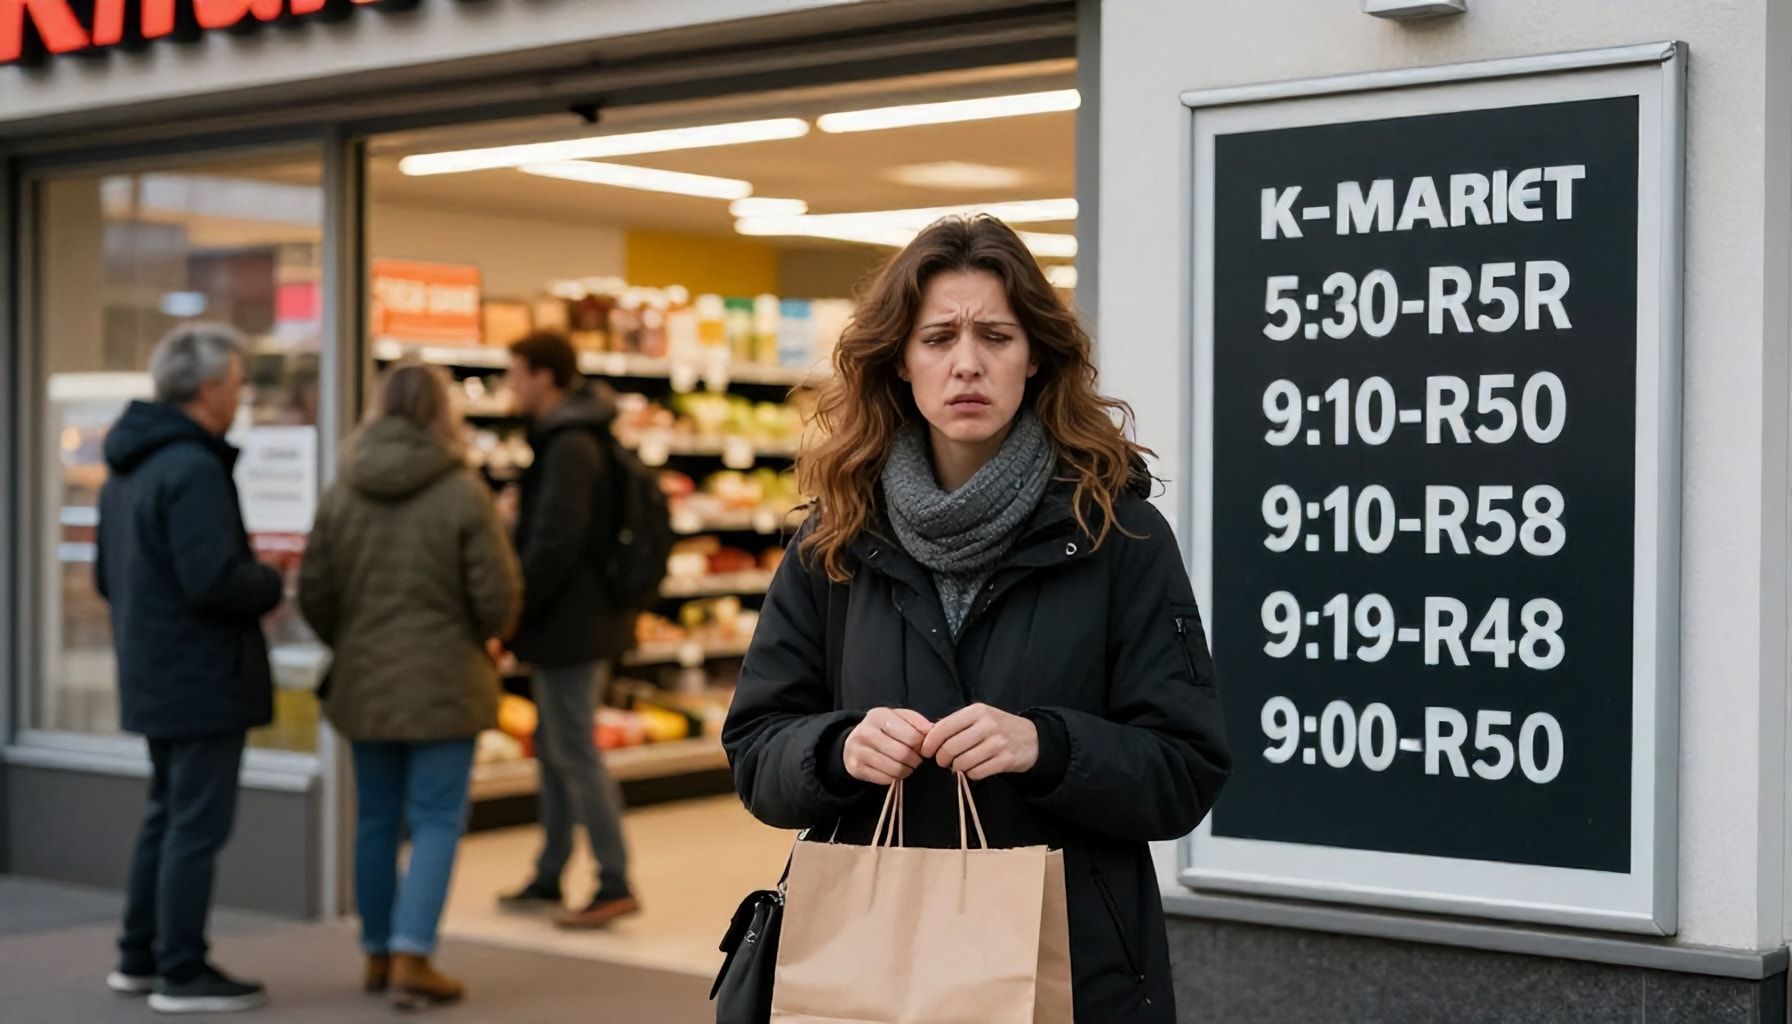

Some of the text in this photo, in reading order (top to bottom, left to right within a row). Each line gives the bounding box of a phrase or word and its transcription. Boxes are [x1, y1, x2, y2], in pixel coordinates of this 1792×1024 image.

[1263, 261, 1573, 341] 5:30-R5R
[1263, 372, 1566, 446] 9:10-R50
[1262, 485, 1566, 556] 9:10-R58
[1261, 591, 1566, 669] 9:19-R48
[1261, 696, 1564, 783] 9:00-R50
